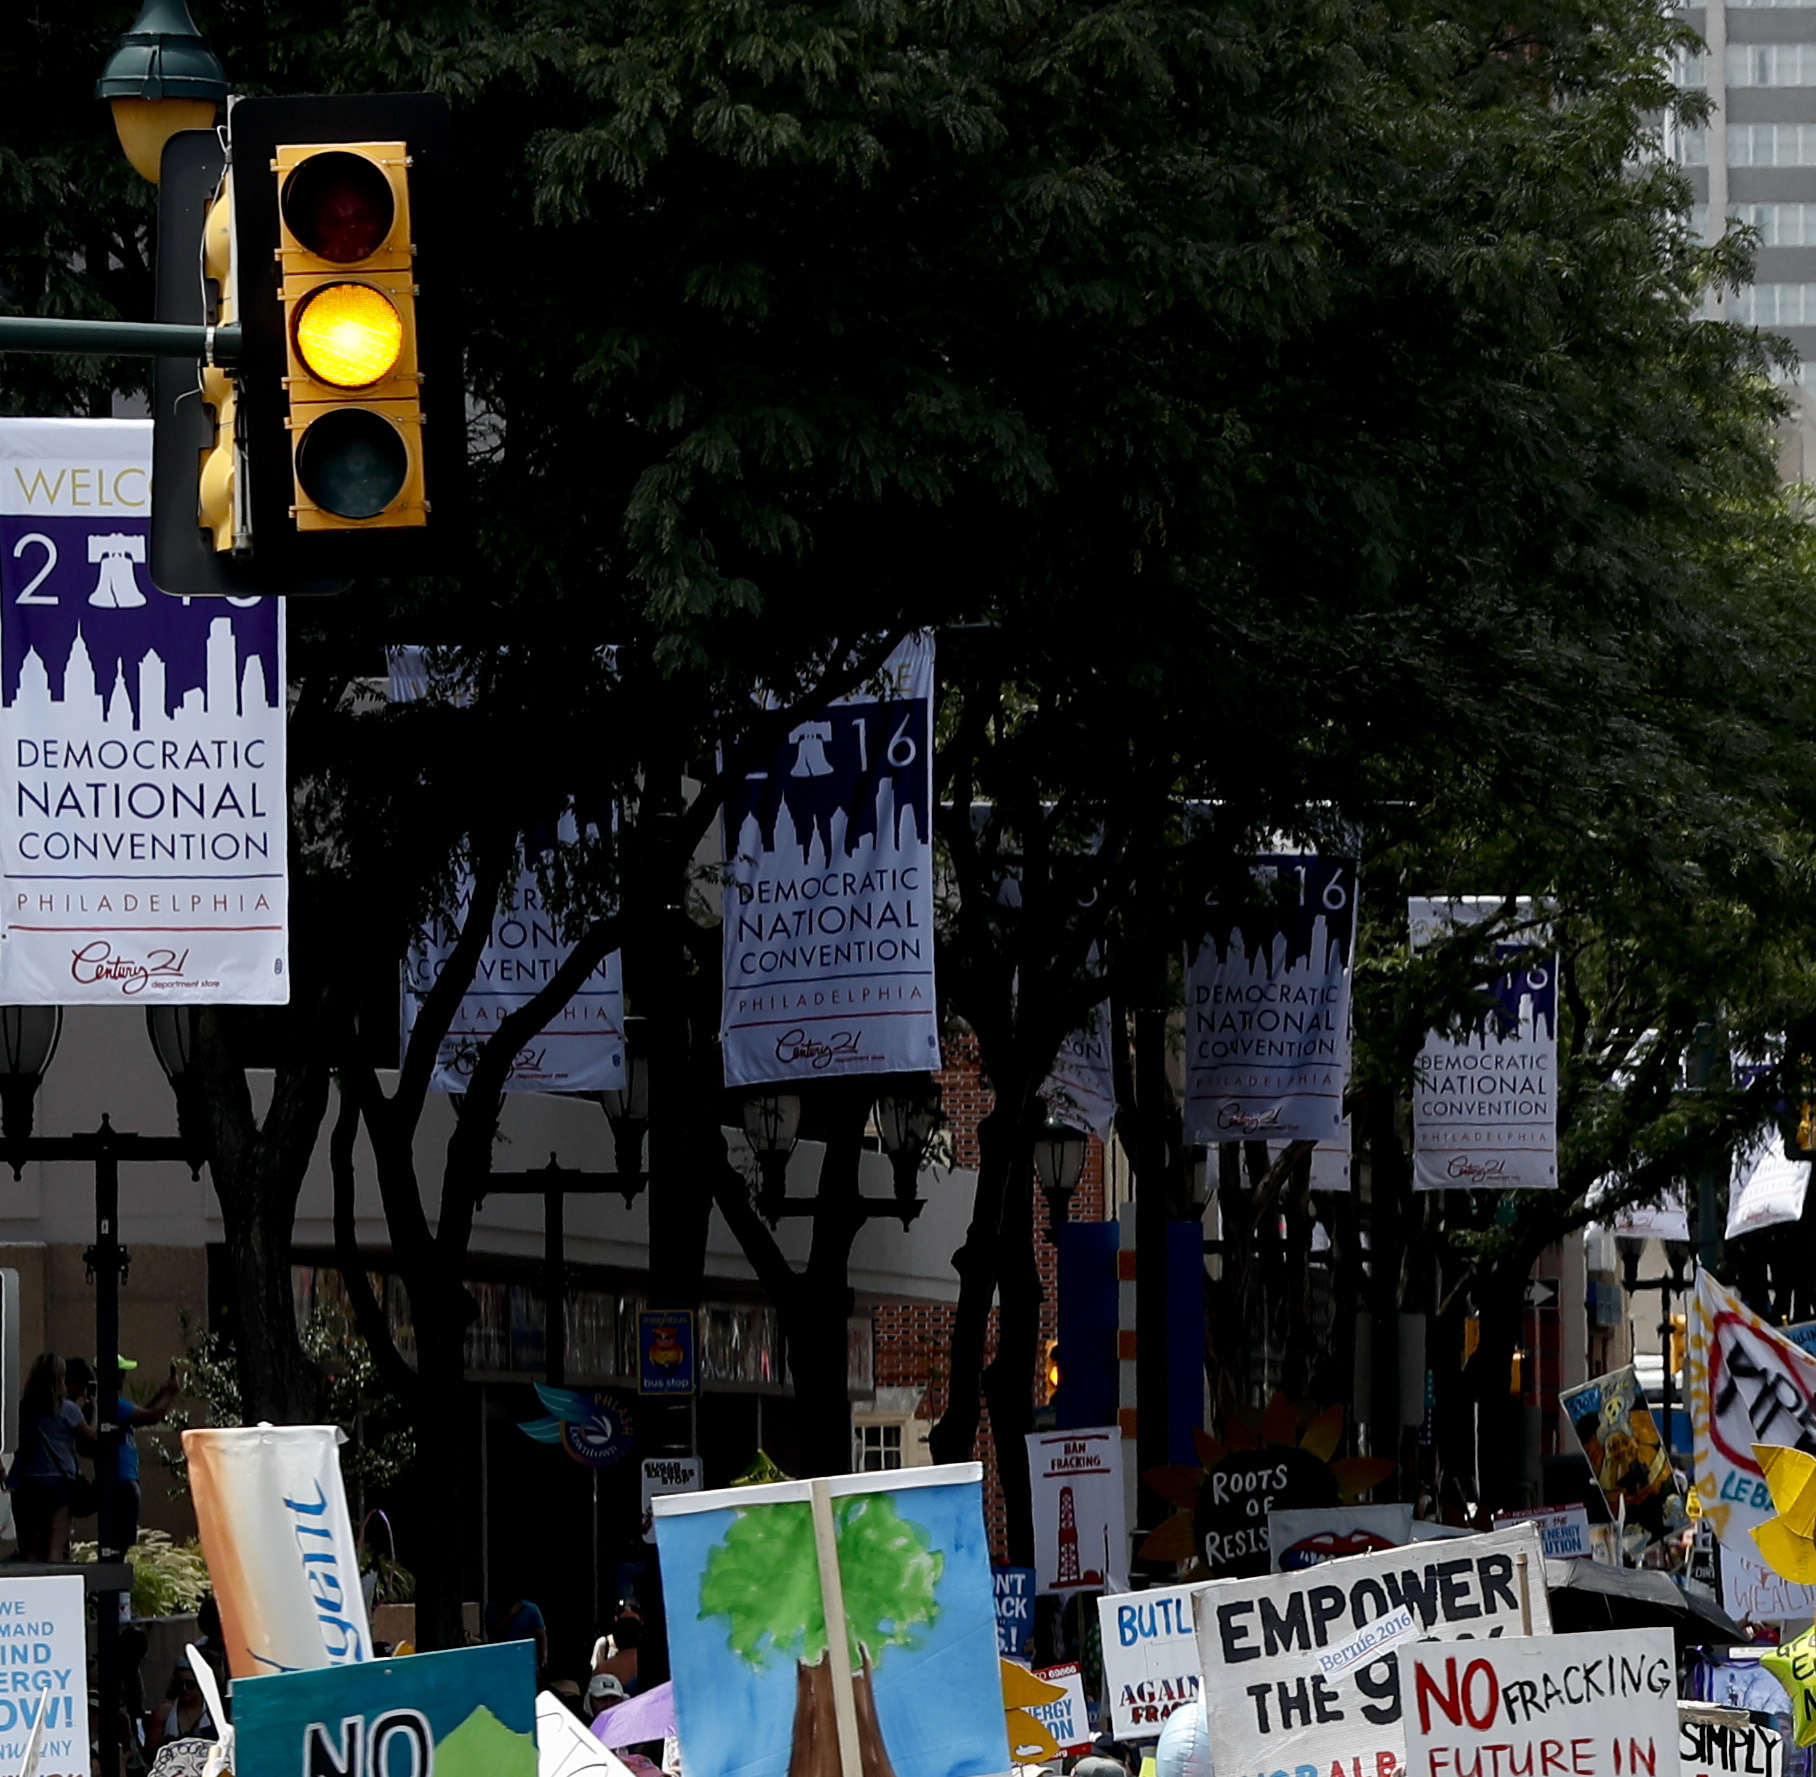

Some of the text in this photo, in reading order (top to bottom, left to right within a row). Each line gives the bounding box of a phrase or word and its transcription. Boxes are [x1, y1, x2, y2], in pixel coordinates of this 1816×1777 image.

[17, 740, 265, 770] DEMOCRATIC
[17, 782, 266, 818] NATIONAL
[19, 832, 268, 860] CONVENTION
[17, 893, 270, 912] PHILADELPHIA
[738, 867, 918, 905] DEMOCRATIC
[739, 901, 919, 942] NATIONAL
[740, 939, 920, 974] CONVENTION
[1051, 1456, 1100, 1471] FRACKING
[1213, 1464, 1288, 1505] ROOTS
[1246, 1497, 1275, 1517] OF
[1216, 1554, 1519, 1664] EMPOWER
[1247, 1675, 1343, 1734] THE
[1413, 1653, 1671, 1735] NO FRACKING
[1613, 1736, 1657, 1777] IN
